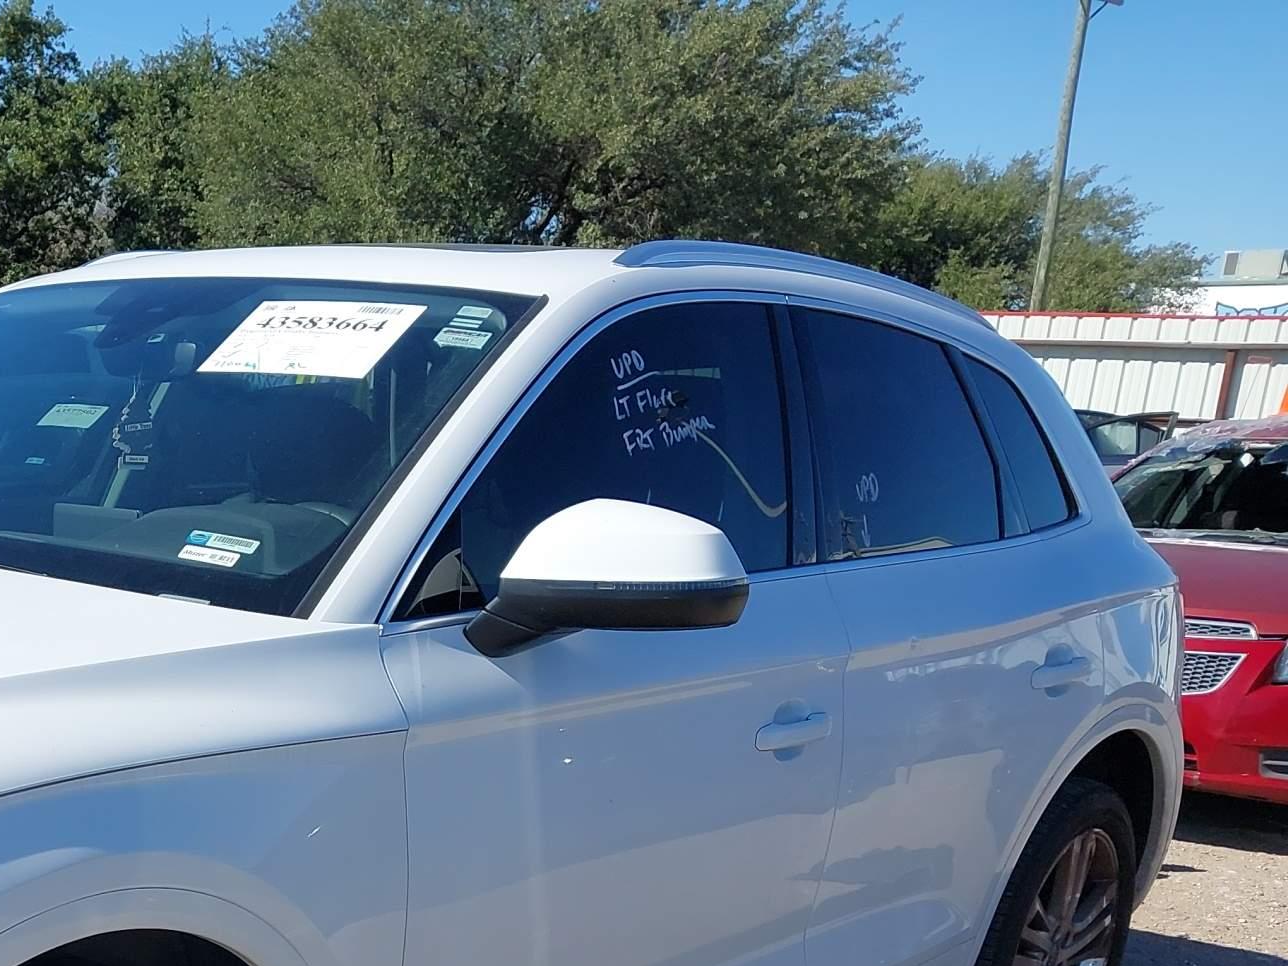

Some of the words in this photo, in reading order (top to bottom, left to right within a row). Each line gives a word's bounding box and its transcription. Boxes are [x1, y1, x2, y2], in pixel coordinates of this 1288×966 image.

[255, 316, 389, 332] 43583664
[610, 350, 645, 379] UPD
[613, 395, 631, 421] LT
[623, 426, 655, 456] FRT
